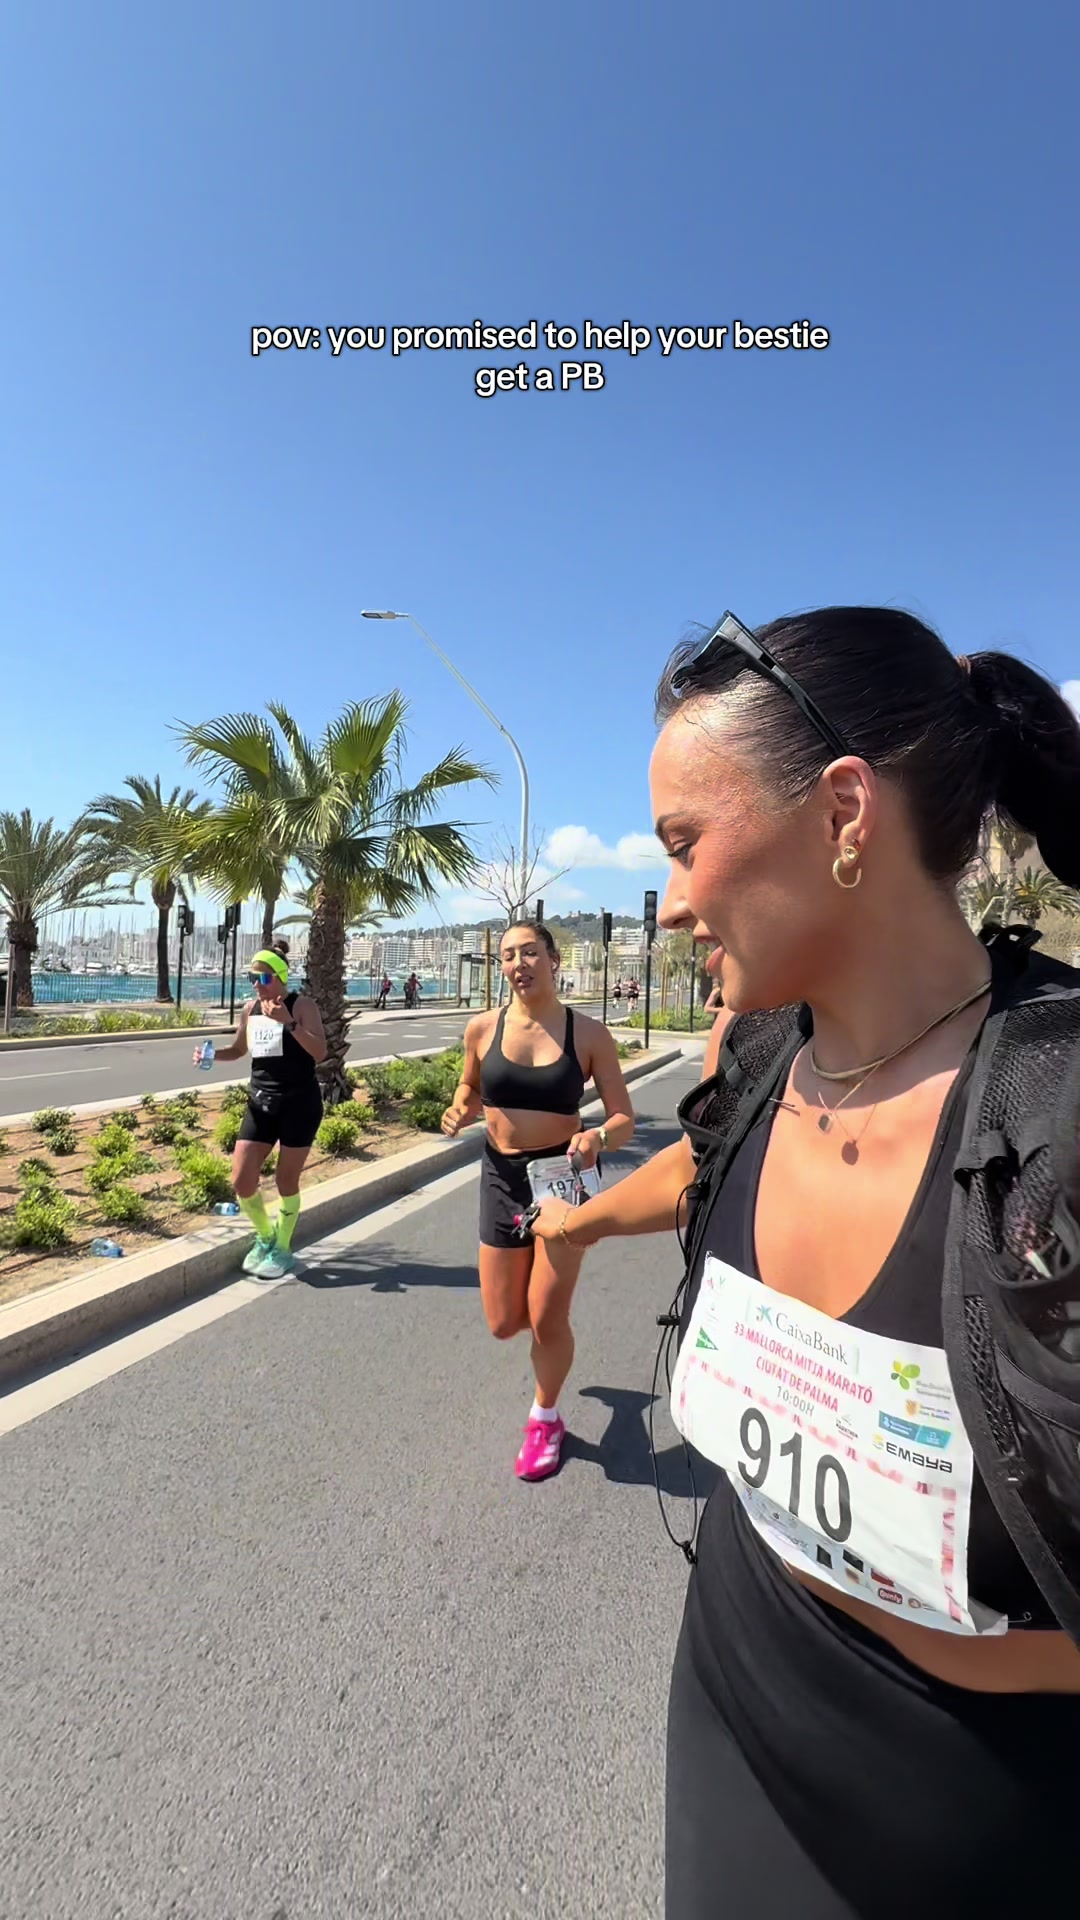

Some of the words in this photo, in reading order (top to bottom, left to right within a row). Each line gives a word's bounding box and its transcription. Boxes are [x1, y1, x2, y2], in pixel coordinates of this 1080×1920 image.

[734, 1321, 745, 1337] 33
[746, 1327, 793, 1363] MALLORCA
[824, 1369, 873, 1404] MARATÓ
[775, 1312, 848, 1365] CaixaBank
[756, 1356, 788, 1383] CIUTAT
[789, 1374, 801, 1391] DE
[803, 1380, 839, 1413] PALMA
[777, 1385, 815, 1417] 10:00H
[737, 1407, 853, 1544] 910
